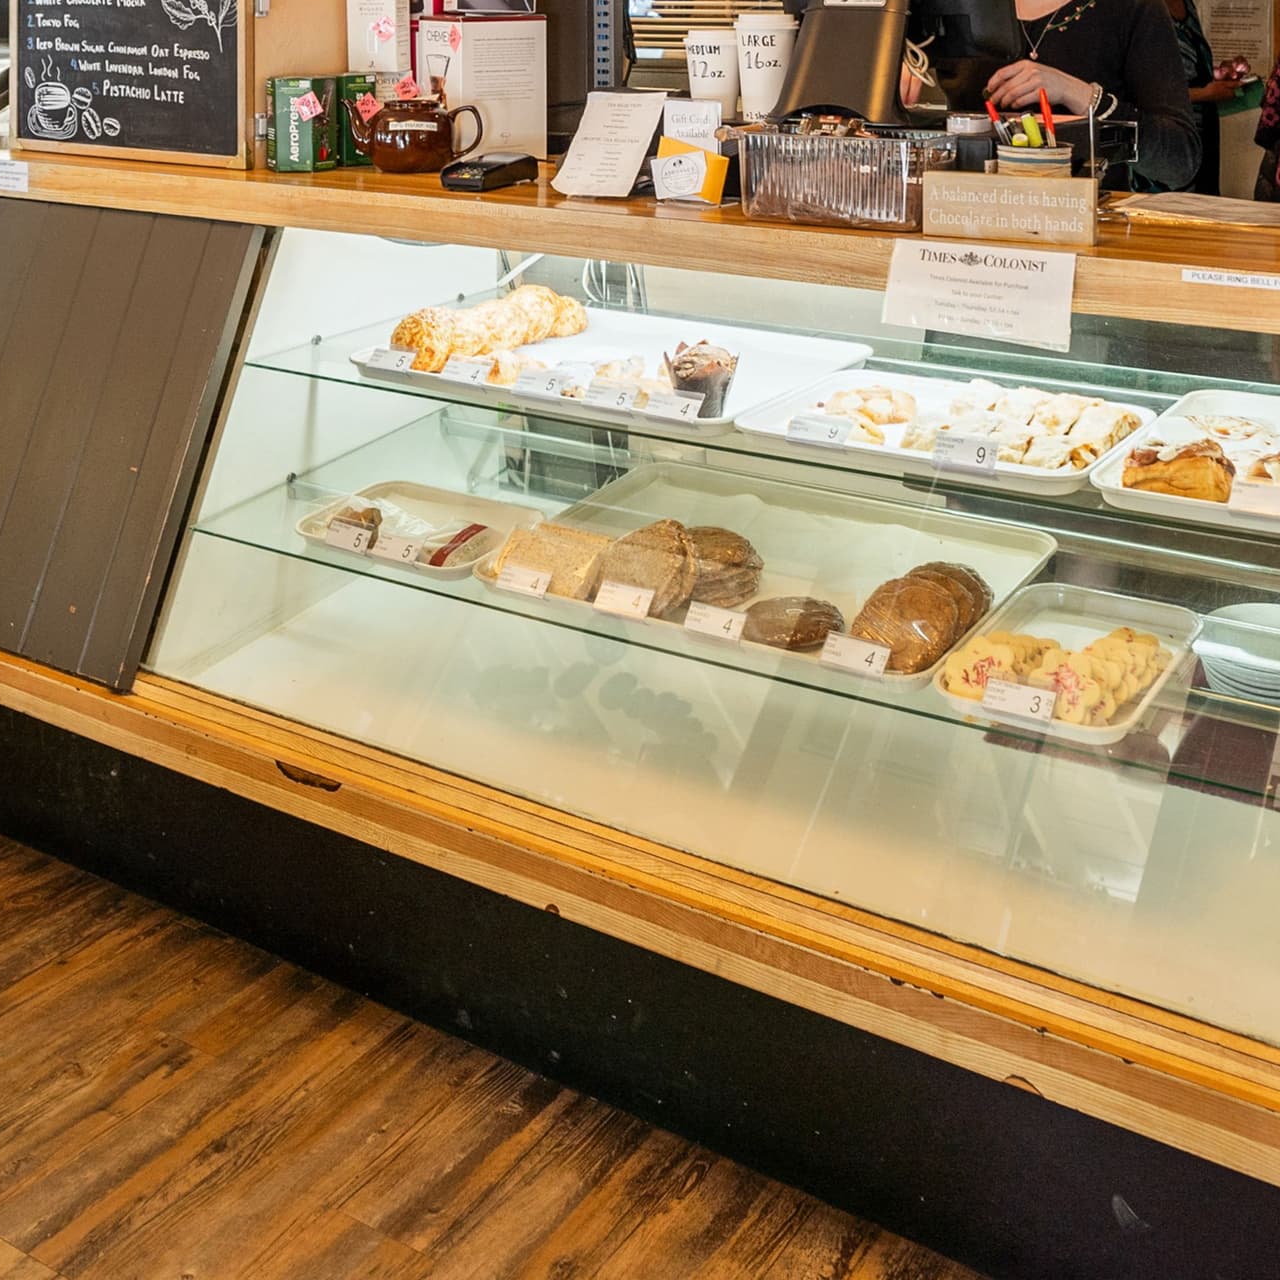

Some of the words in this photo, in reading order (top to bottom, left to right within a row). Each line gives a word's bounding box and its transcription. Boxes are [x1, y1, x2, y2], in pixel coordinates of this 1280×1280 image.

[687, 45, 721, 55] MEDIUM
[741, 35, 776, 47] LARGE
[691, 60, 725, 78] 12oz.
[745, 51, 781, 69] 16oz.
[929, 186, 939, 201] A
[942, 187, 997, 205] balanced
[1000, 189, 1025, 206] diet
[1028, 190, 1039, 205] is
[1042, 192, 1087, 214] having
[928, 208, 992, 226] Chocolate
[996, 212, 1009, 227] in
[1011, 213, 1041, 230] both
[1044, 216, 1084, 233] hands
[920, 248, 957, 264] TIMES
[983, 255, 1047, 273] COLONIST
[1191, 272, 1225, 282] PLEASE
[1226, 276, 1248, 285] RING
[1250, 277, 1272, 287] BELL
